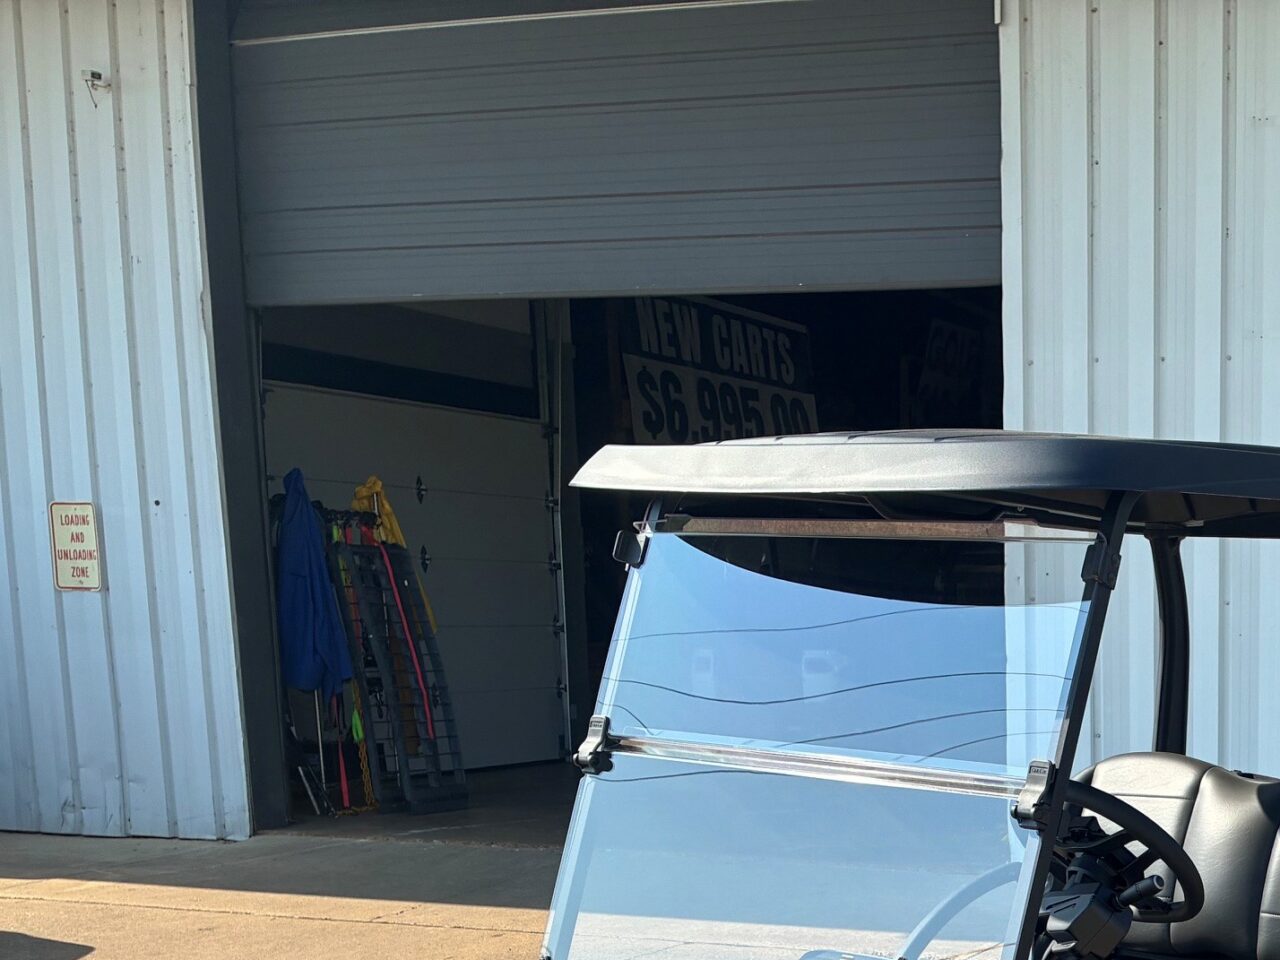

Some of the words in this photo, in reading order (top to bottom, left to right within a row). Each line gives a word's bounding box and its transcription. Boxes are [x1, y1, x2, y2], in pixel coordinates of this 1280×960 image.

[635, 296, 702, 364] NEW
[711, 314, 795, 385] CARTS
[60, 514, 90, 526] LOADING
[70, 532, 85, 543] AND
[57, 549, 97, 560] UNLOADING
[71, 566, 90, 578] ZONE
